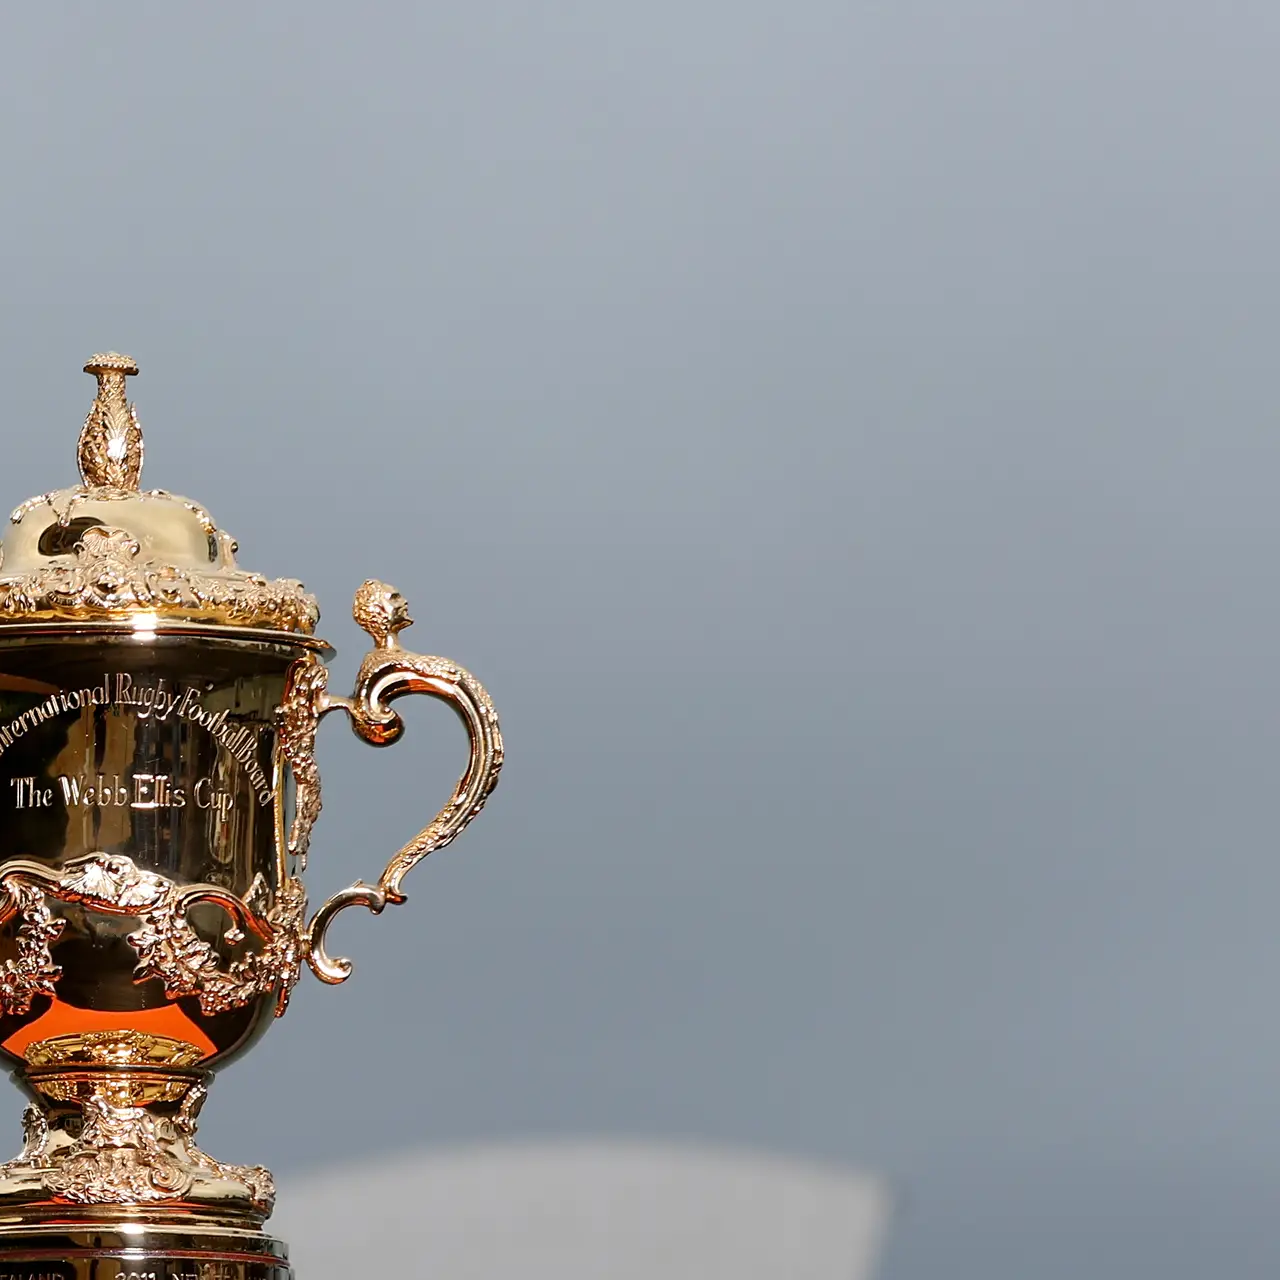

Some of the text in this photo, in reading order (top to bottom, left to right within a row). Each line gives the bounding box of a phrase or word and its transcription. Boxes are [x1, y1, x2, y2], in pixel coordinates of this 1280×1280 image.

[114, 672, 182, 721] Rugby
[177, 686, 250, 752] Football
[235, 735, 278, 807] Board
[10, 774, 233, 822] The Webb Ellis Cup
